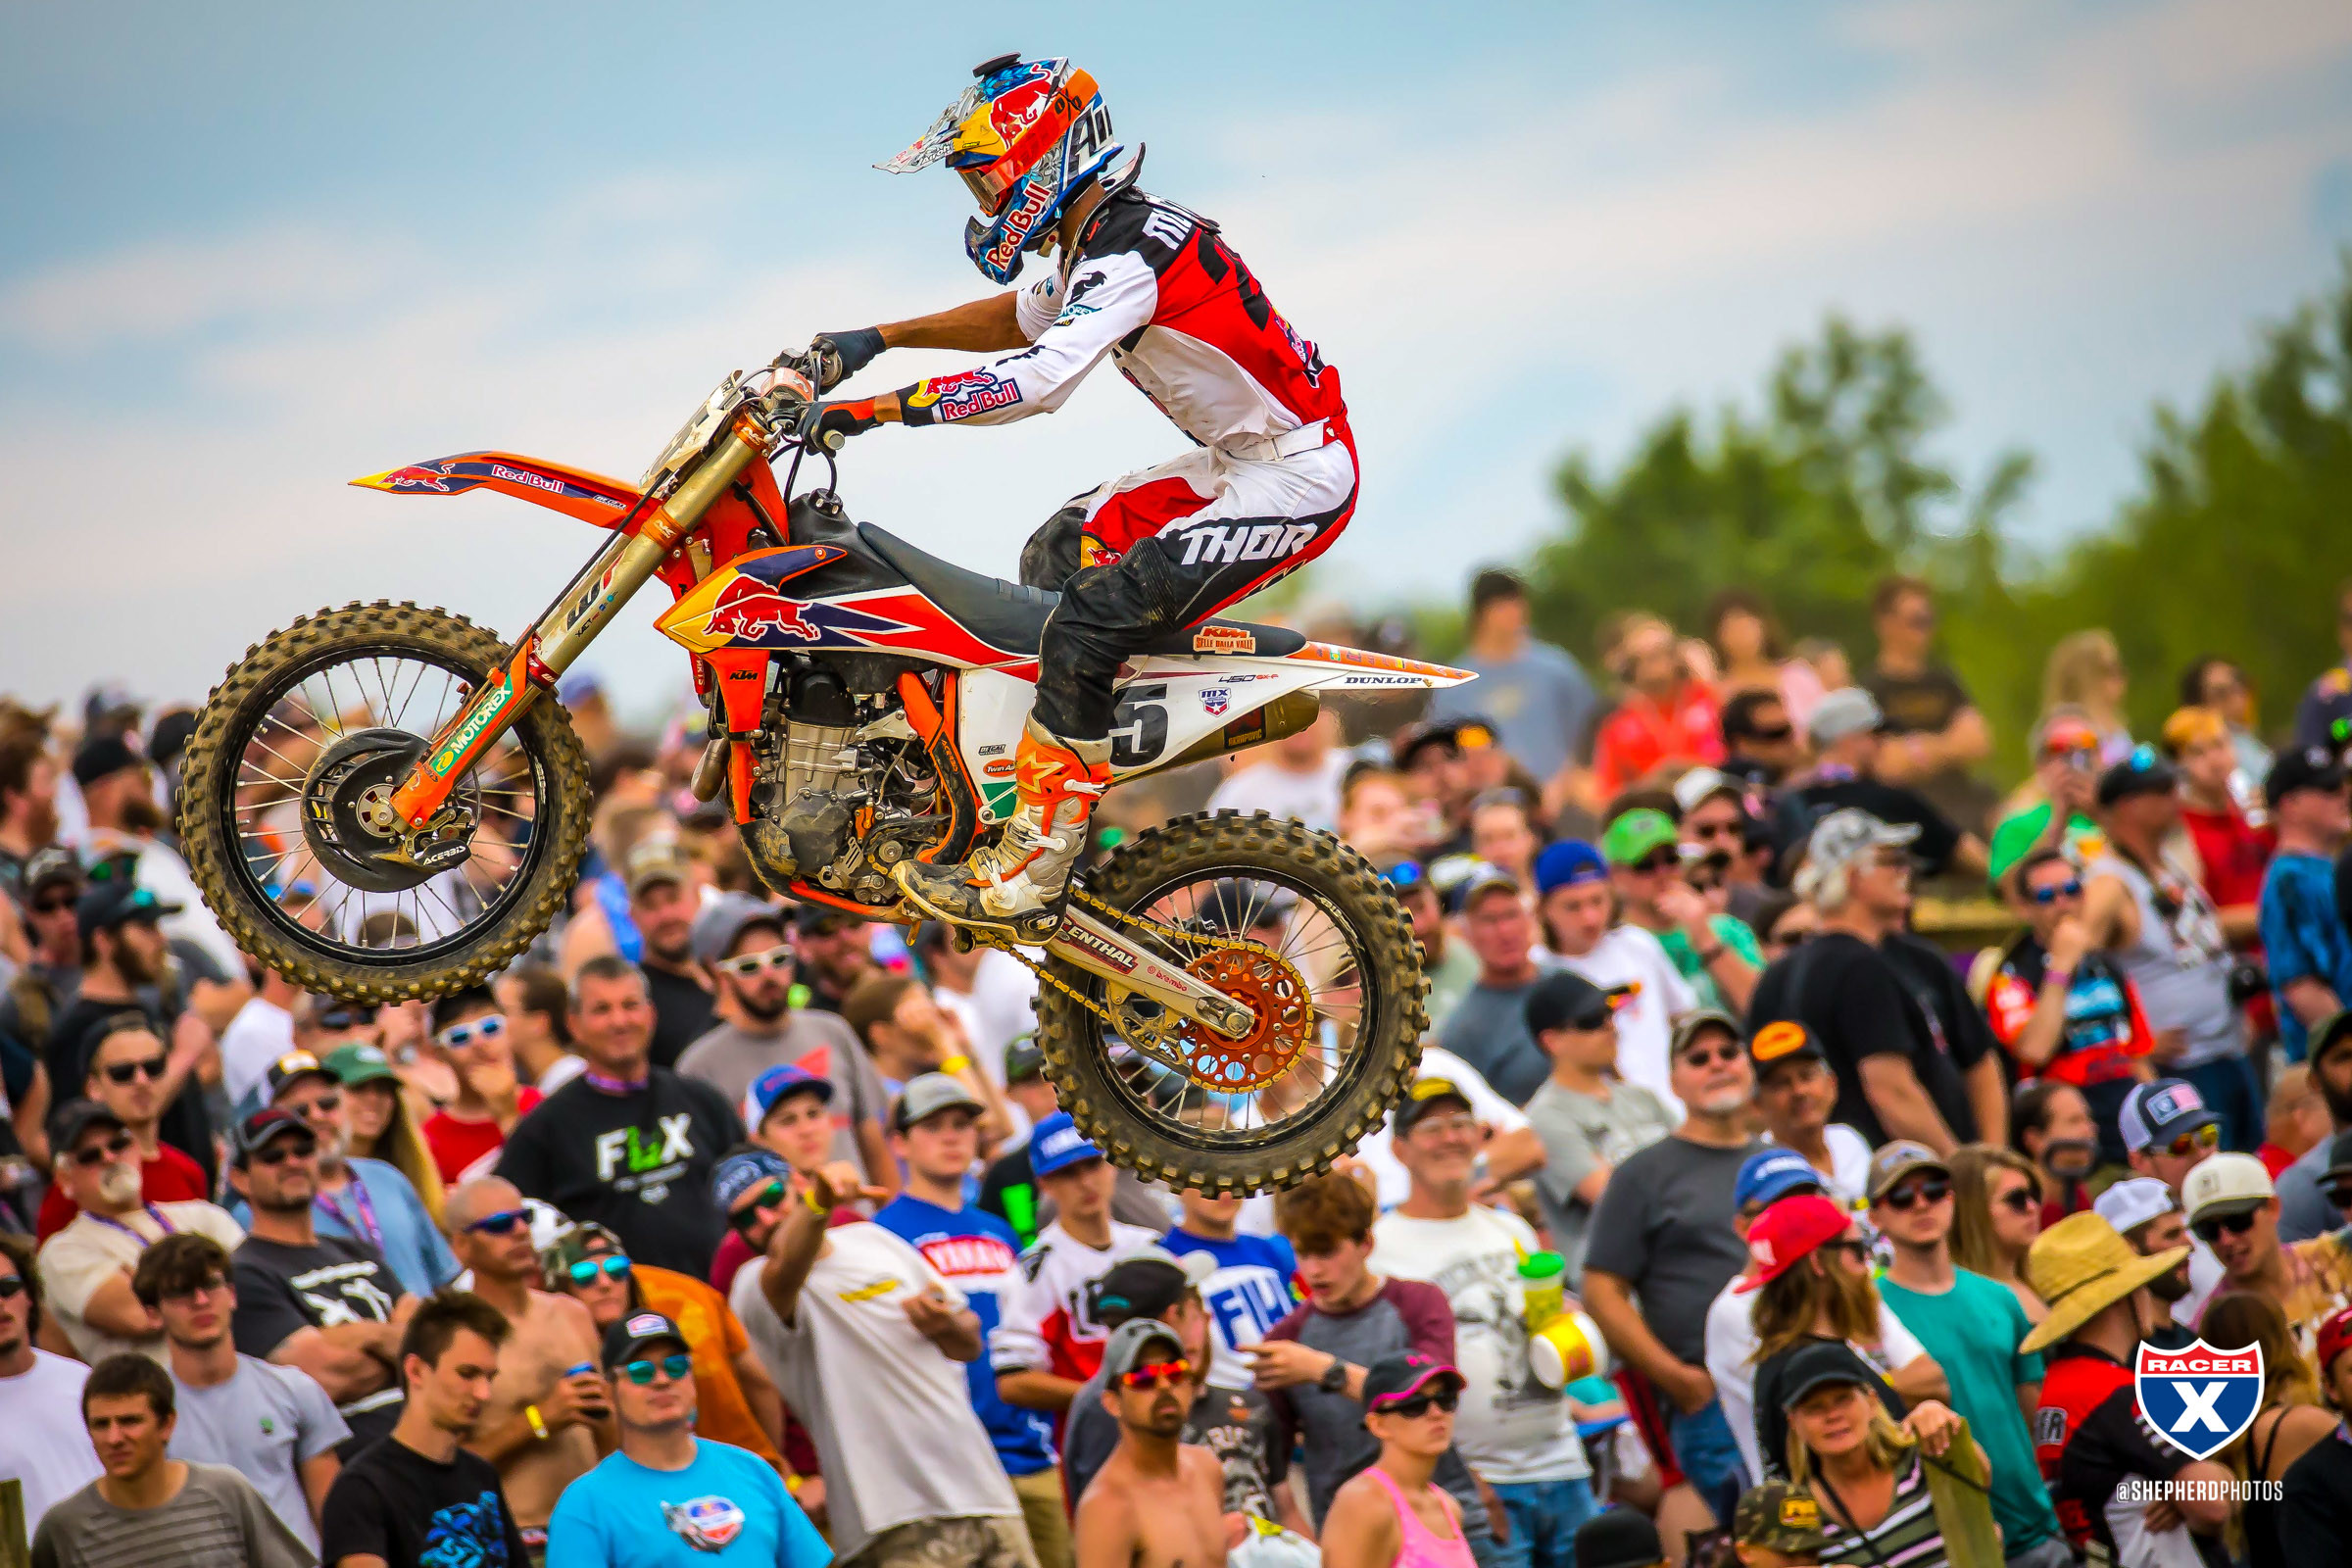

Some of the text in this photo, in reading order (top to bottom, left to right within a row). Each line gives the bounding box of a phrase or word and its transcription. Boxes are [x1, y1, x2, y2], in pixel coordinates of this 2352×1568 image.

[986, 183, 1053, 271] Red Bull
[943, 382, 1019, 420] Red Bull
[492, 465, 564, 494] Red Bull
[1178, 522, 1318, 565] THOR
[1196, 637, 1253, 651] SELLE DALLA VALLE
[1202, 627, 1248, 639] KTM
[729, 669, 760, 680] KTM
[1218, 674, 1257, 684] 450
[1344, 676, 1423, 685] DUNLOP
[450, 683, 513, 755] MOTOREX
[1110, 683, 1169, 768] 5
[987, 764, 1004, 774] Twin
[422, 845, 466, 866] ACERBIS
[1155, 969, 1188, 993] brembo
